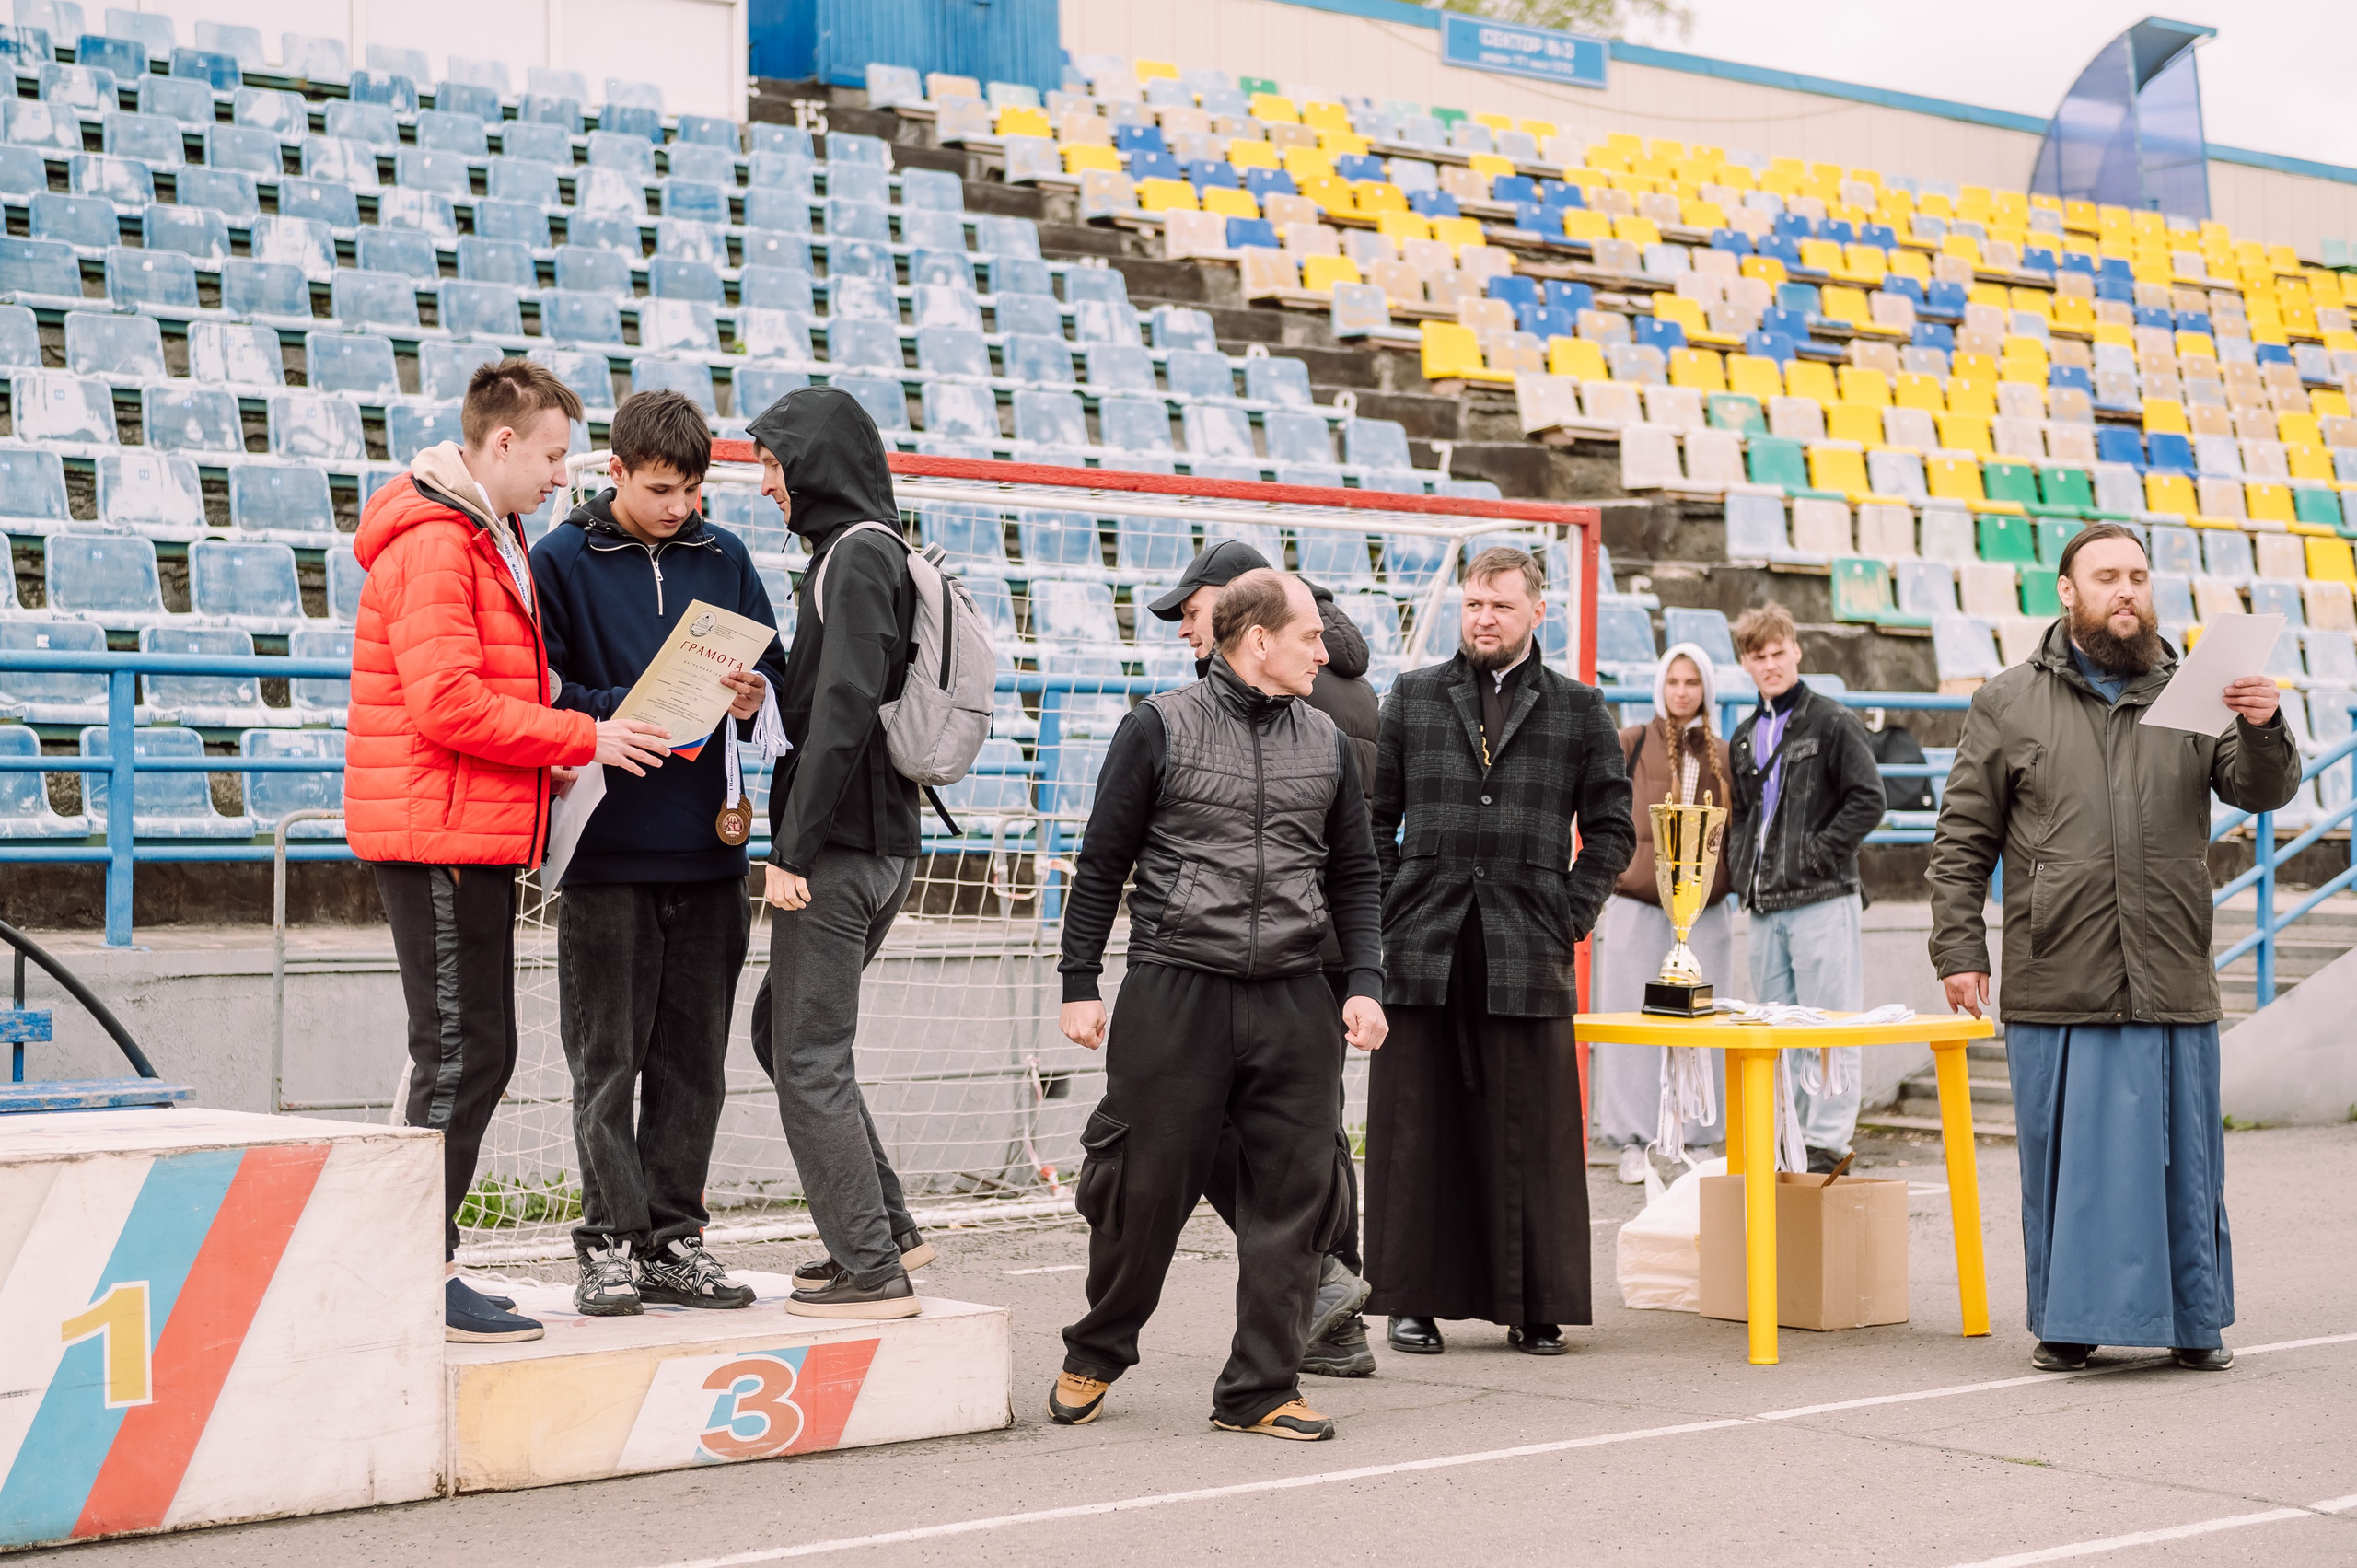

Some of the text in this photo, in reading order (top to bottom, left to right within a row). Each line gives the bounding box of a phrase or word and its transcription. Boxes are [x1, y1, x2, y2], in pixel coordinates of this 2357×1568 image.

[790, 99, 828, 135] 15
[1430, 440, 1453, 473] 7
[679, 640, 744, 672] ГРАМОТА
[1295, 791, 1323, 802] adidas
[61, 1280, 153, 1409] 1
[700, 1354, 805, 1459] 3
